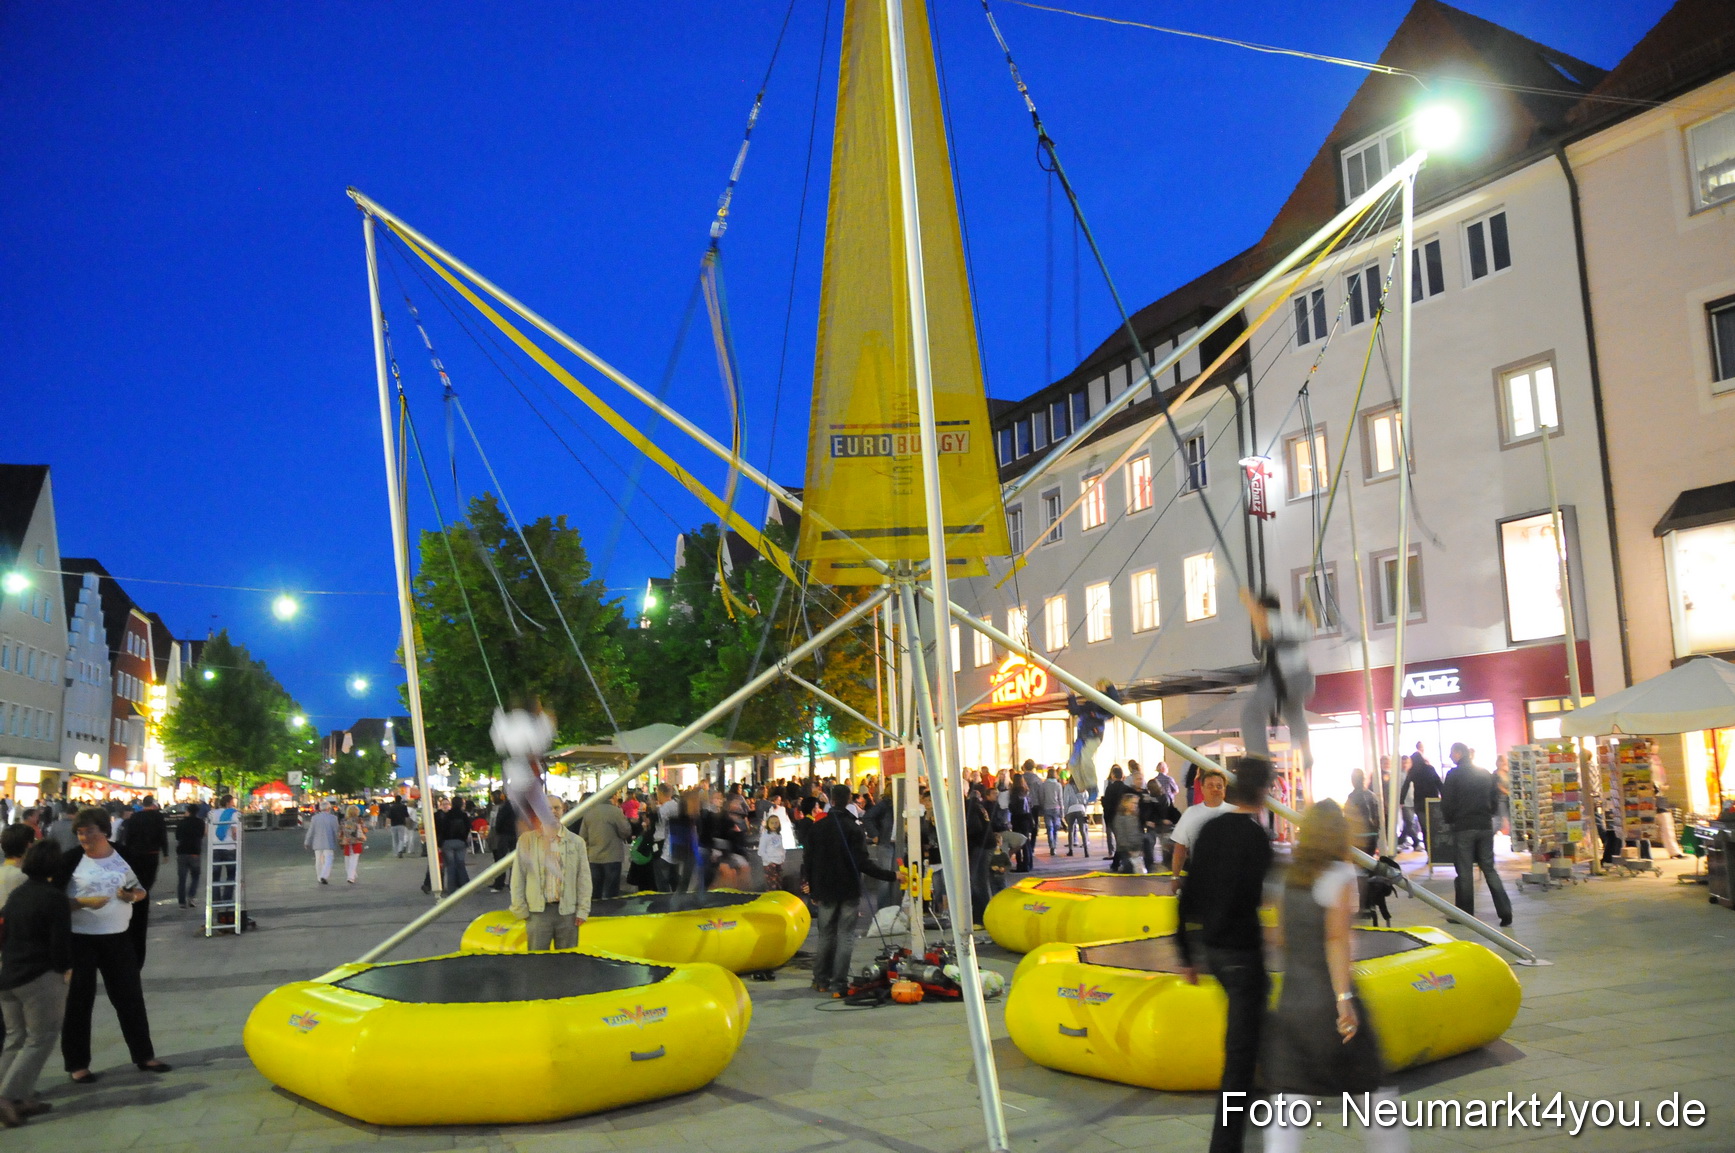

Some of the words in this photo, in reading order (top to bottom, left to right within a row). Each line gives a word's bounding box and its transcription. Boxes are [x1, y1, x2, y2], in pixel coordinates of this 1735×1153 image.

[834, 433, 966, 456] EUROBUGY
[1250, 468, 1264, 512] Achatz
[990, 666, 1047, 703] RENO
